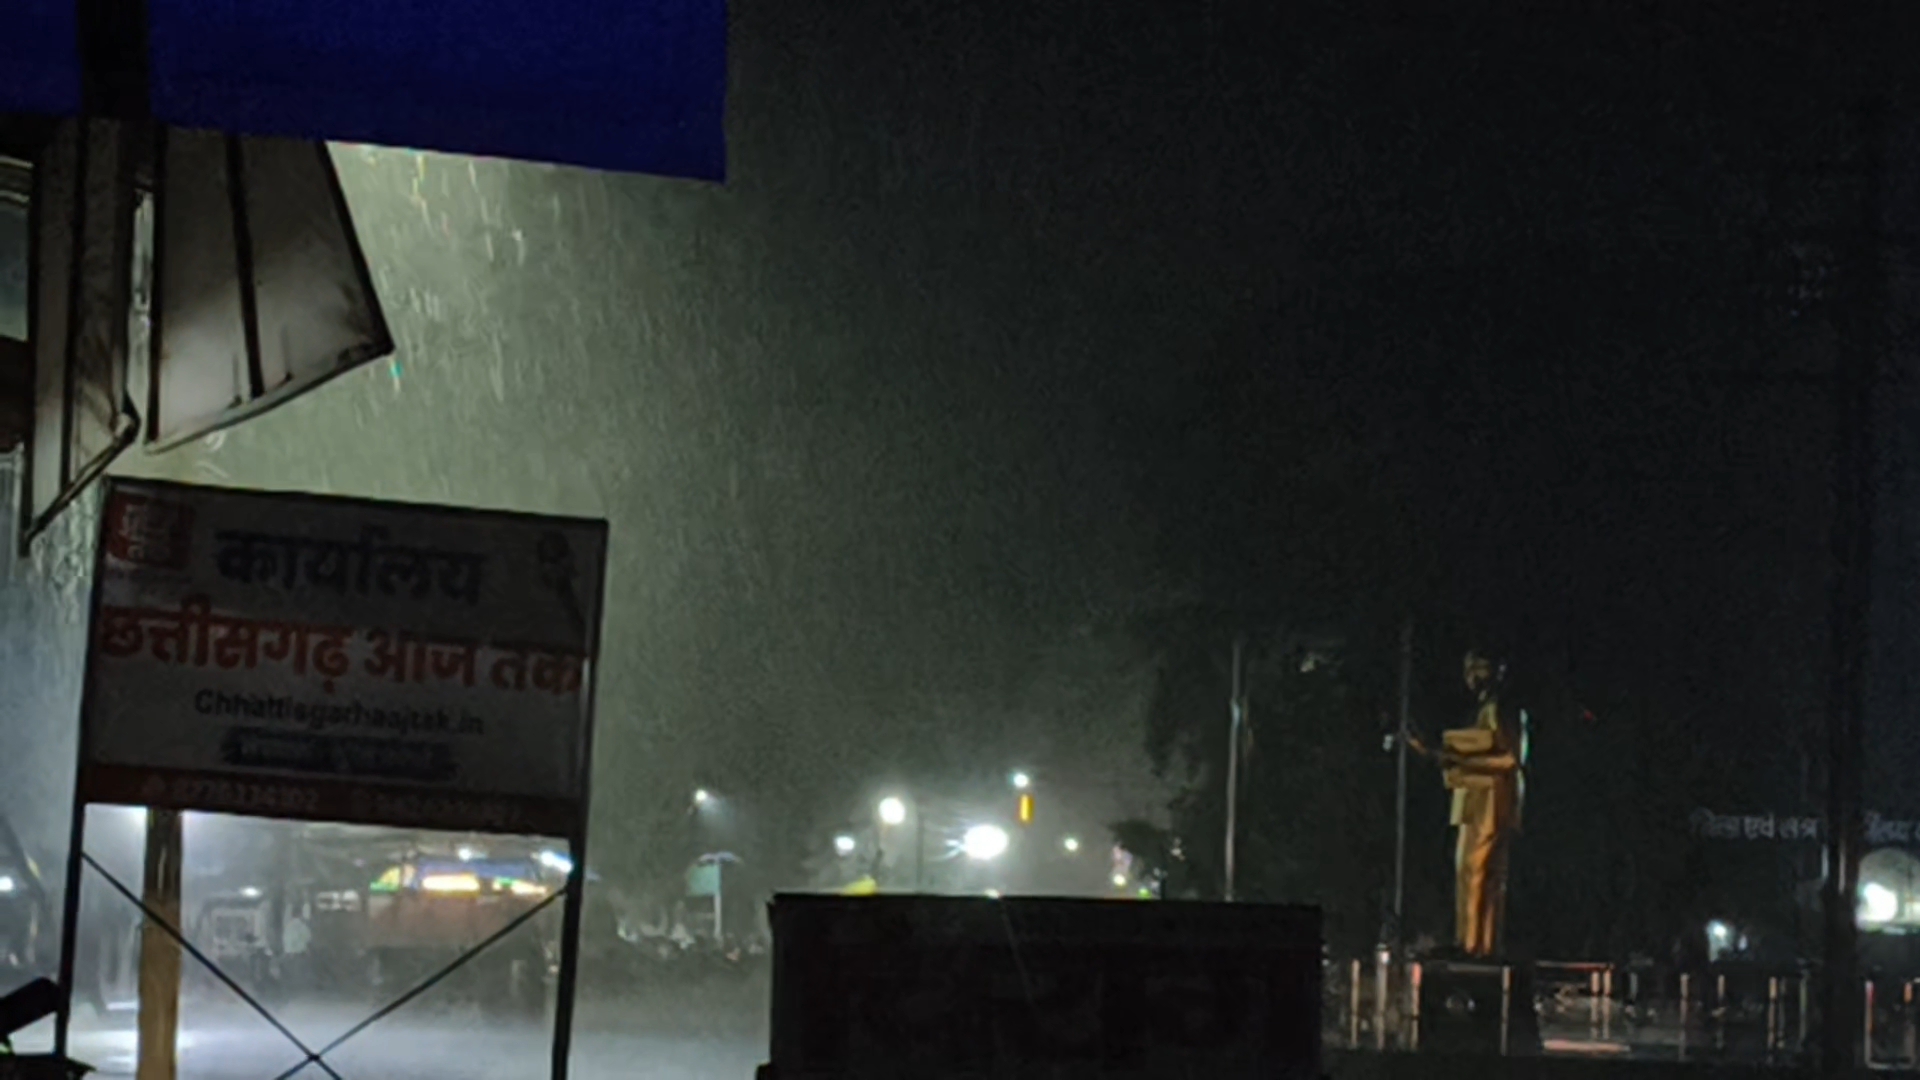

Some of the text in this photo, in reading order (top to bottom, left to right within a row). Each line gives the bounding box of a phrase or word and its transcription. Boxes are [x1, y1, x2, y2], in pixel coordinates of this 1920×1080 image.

[214, 526, 488, 606] कार्यालय
[99, 595, 584, 698] छत्तीसगढ़ आज तक
